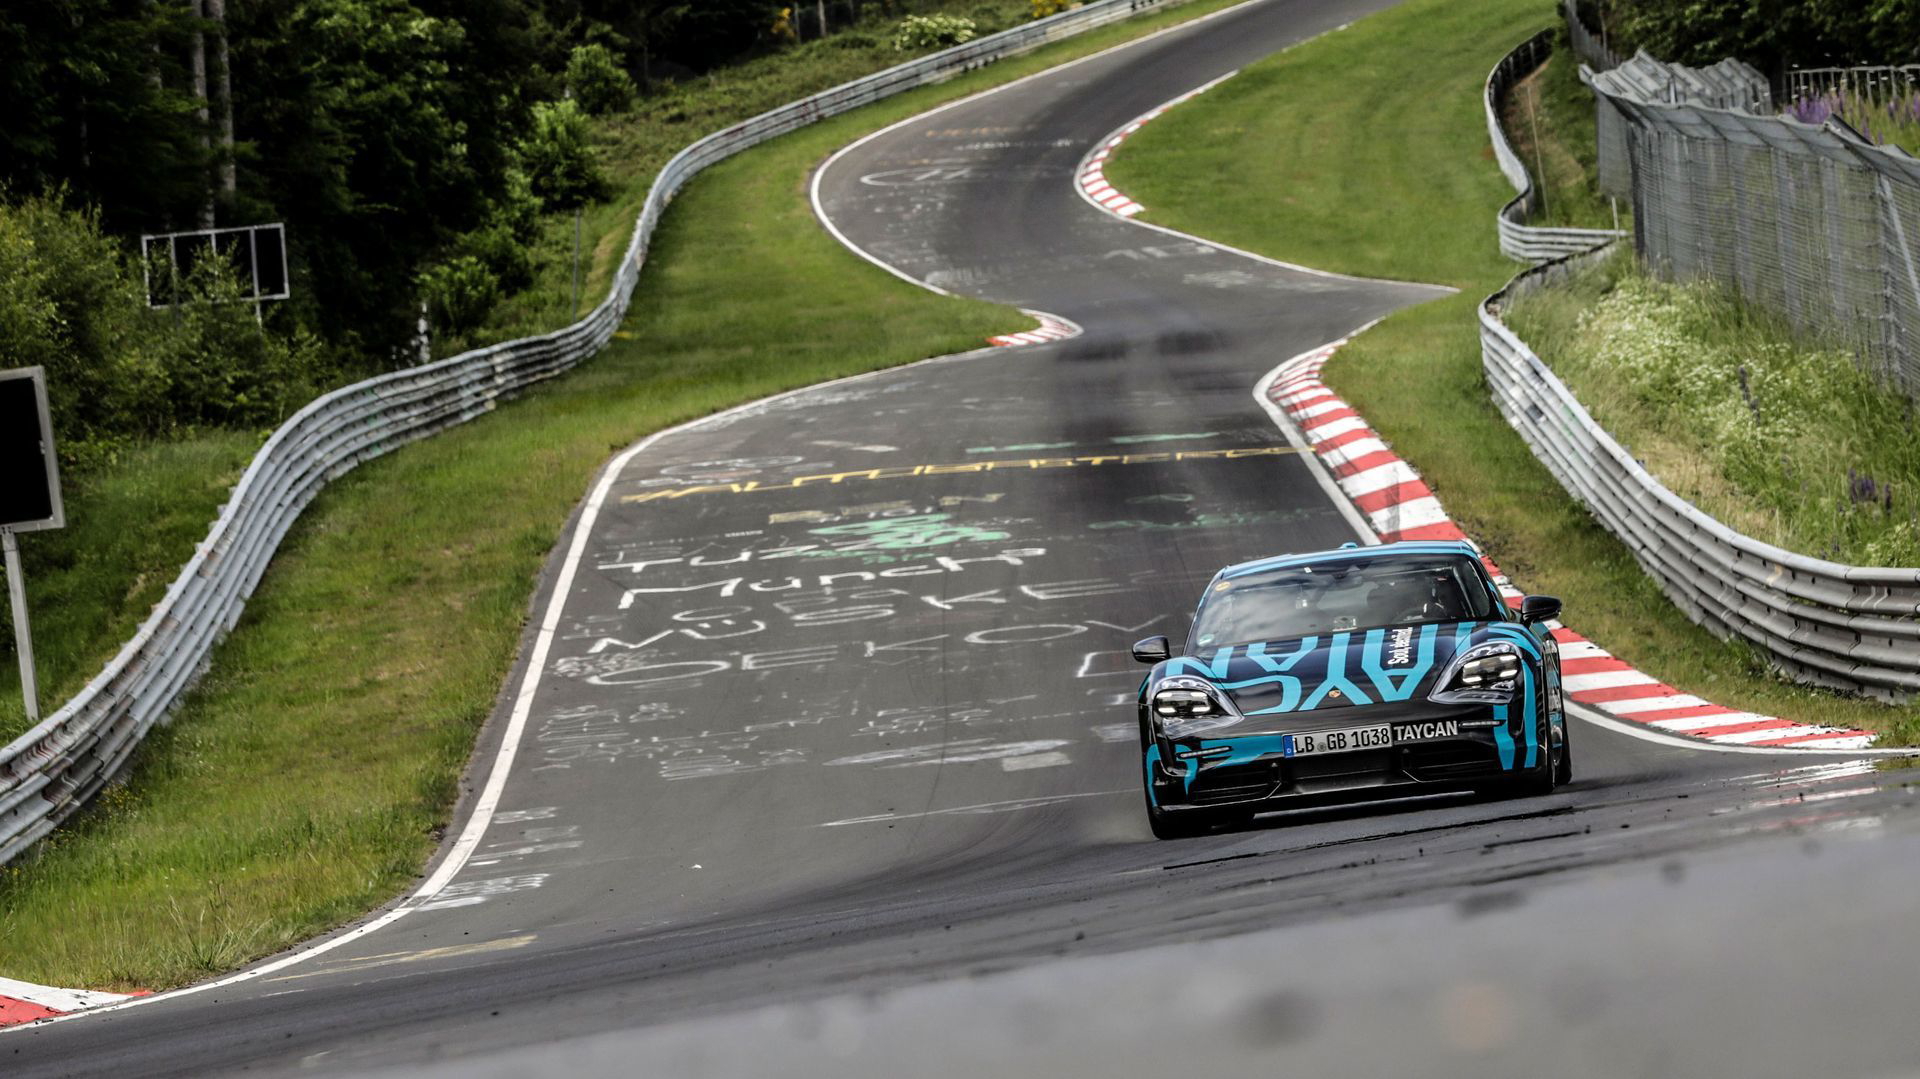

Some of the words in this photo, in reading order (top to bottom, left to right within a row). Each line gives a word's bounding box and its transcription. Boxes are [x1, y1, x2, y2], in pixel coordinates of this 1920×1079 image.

[1294, 736, 1314, 753] LB
[1327, 733, 1347, 751] GB
[1351, 728, 1390, 748] 1038
[1394, 720, 1458, 741] TAYCAN
